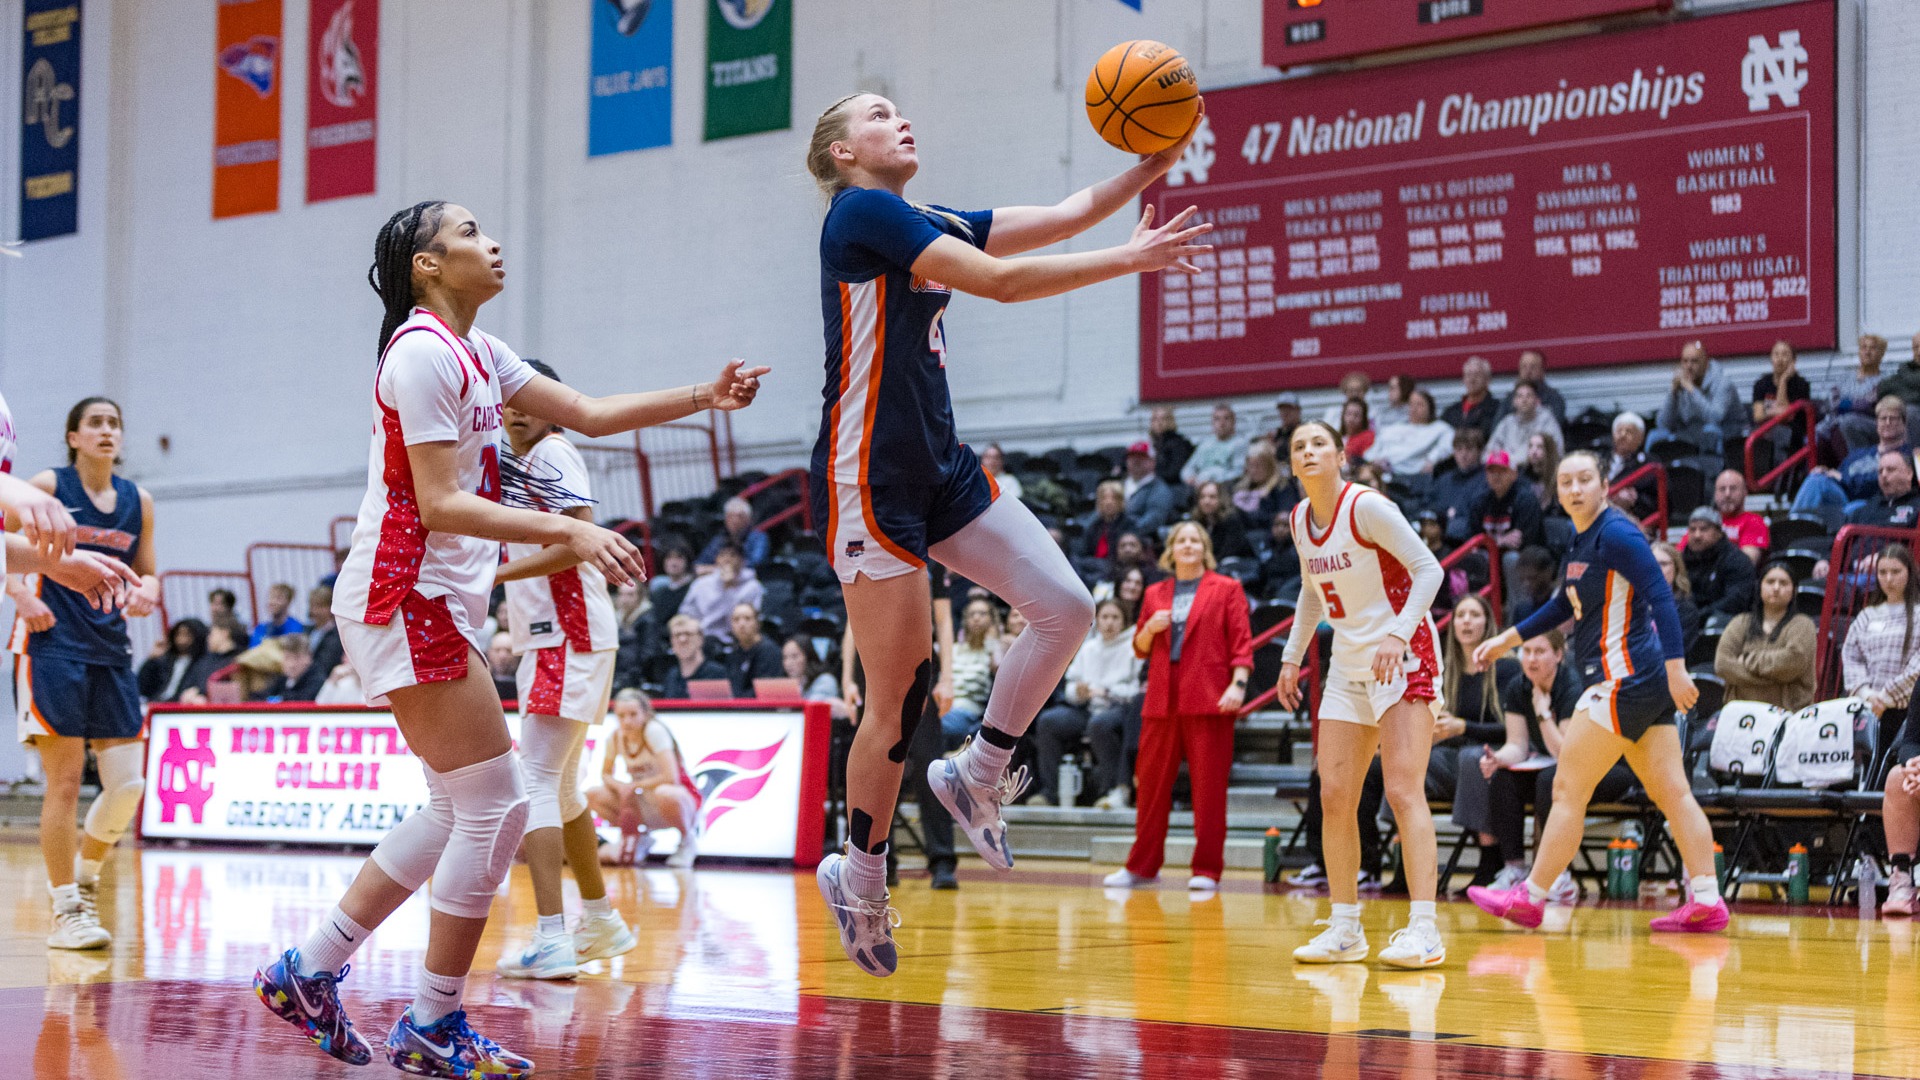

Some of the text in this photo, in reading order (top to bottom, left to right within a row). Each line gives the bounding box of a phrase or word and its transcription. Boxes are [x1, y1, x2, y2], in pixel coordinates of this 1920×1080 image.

[711, 53, 778, 87] TITANS
[1241, 66, 1706, 165] 47 National Championships
[1688, 142, 1765, 169] WOMEN'S
[1447, 172, 1515, 198] OUTDOOR
[1676, 165, 1776, 195] BASKETBALL
[1407, 195, 1508, 224] TRACK & FIELD
[1537, 182, 1638, 211] SWIMMING &
[1710, 192, 1742, 215] 1983
[1285, 211, 1382, 237] TRACK & FIELD
[1533, 206, 1640, 234] DIVING (NAIA)
[1605, 229, 1639, 250] 1962,
[1689, 233, 1767, 260] WOMEN'S
[1659, 255, 1800, 285] TRIATHLON (USAT)
[1333, 282, 1403, 304] WRESTLING
[1420, 290, 1490, 314] FOOTBALL
[1732, 278, 1770, 301] 2019,
[1319, 581, 1347, 620] 5
[231, 726, 310, 753] NORTH
[1819, 723, 1838, 742] G
[1798, 751, 1853, 765] GATOR
[157, 728, 216, 823] NC
[275, 761, 381, 790] COLLEGE
[227, 801, 422, 829] GREGORY AREN
